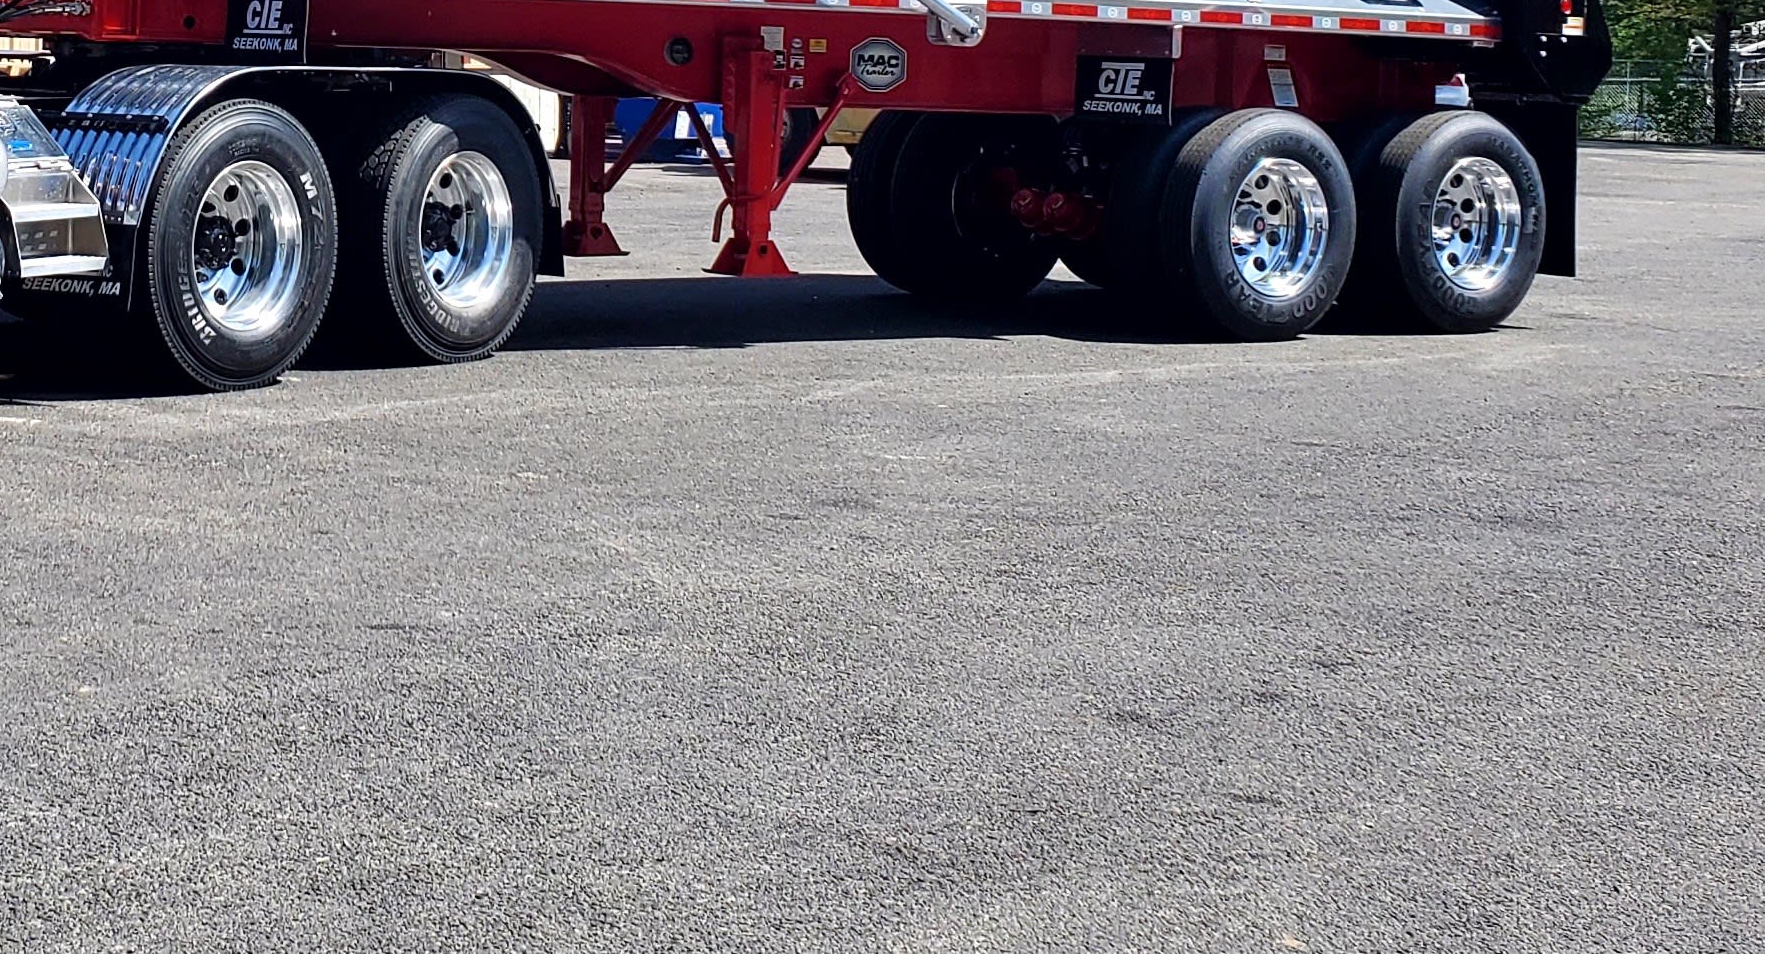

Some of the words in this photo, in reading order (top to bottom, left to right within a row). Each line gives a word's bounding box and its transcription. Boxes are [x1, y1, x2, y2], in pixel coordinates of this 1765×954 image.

[232, 37, 282, 53] SEEKONK,
[284, 38, 298, 50] MA
[857, 54, 900, 69] MAC
[860, 63, 896, 77] Trailer
[1098, 61, 1145, 95] CTE
[1083, 100, 1143, 117] SEEKONK,
[1144, 103, 1163, 115] MA
[22, 277, 95, 297] SEEKONK,
[98, 281, 121, 295] MA
